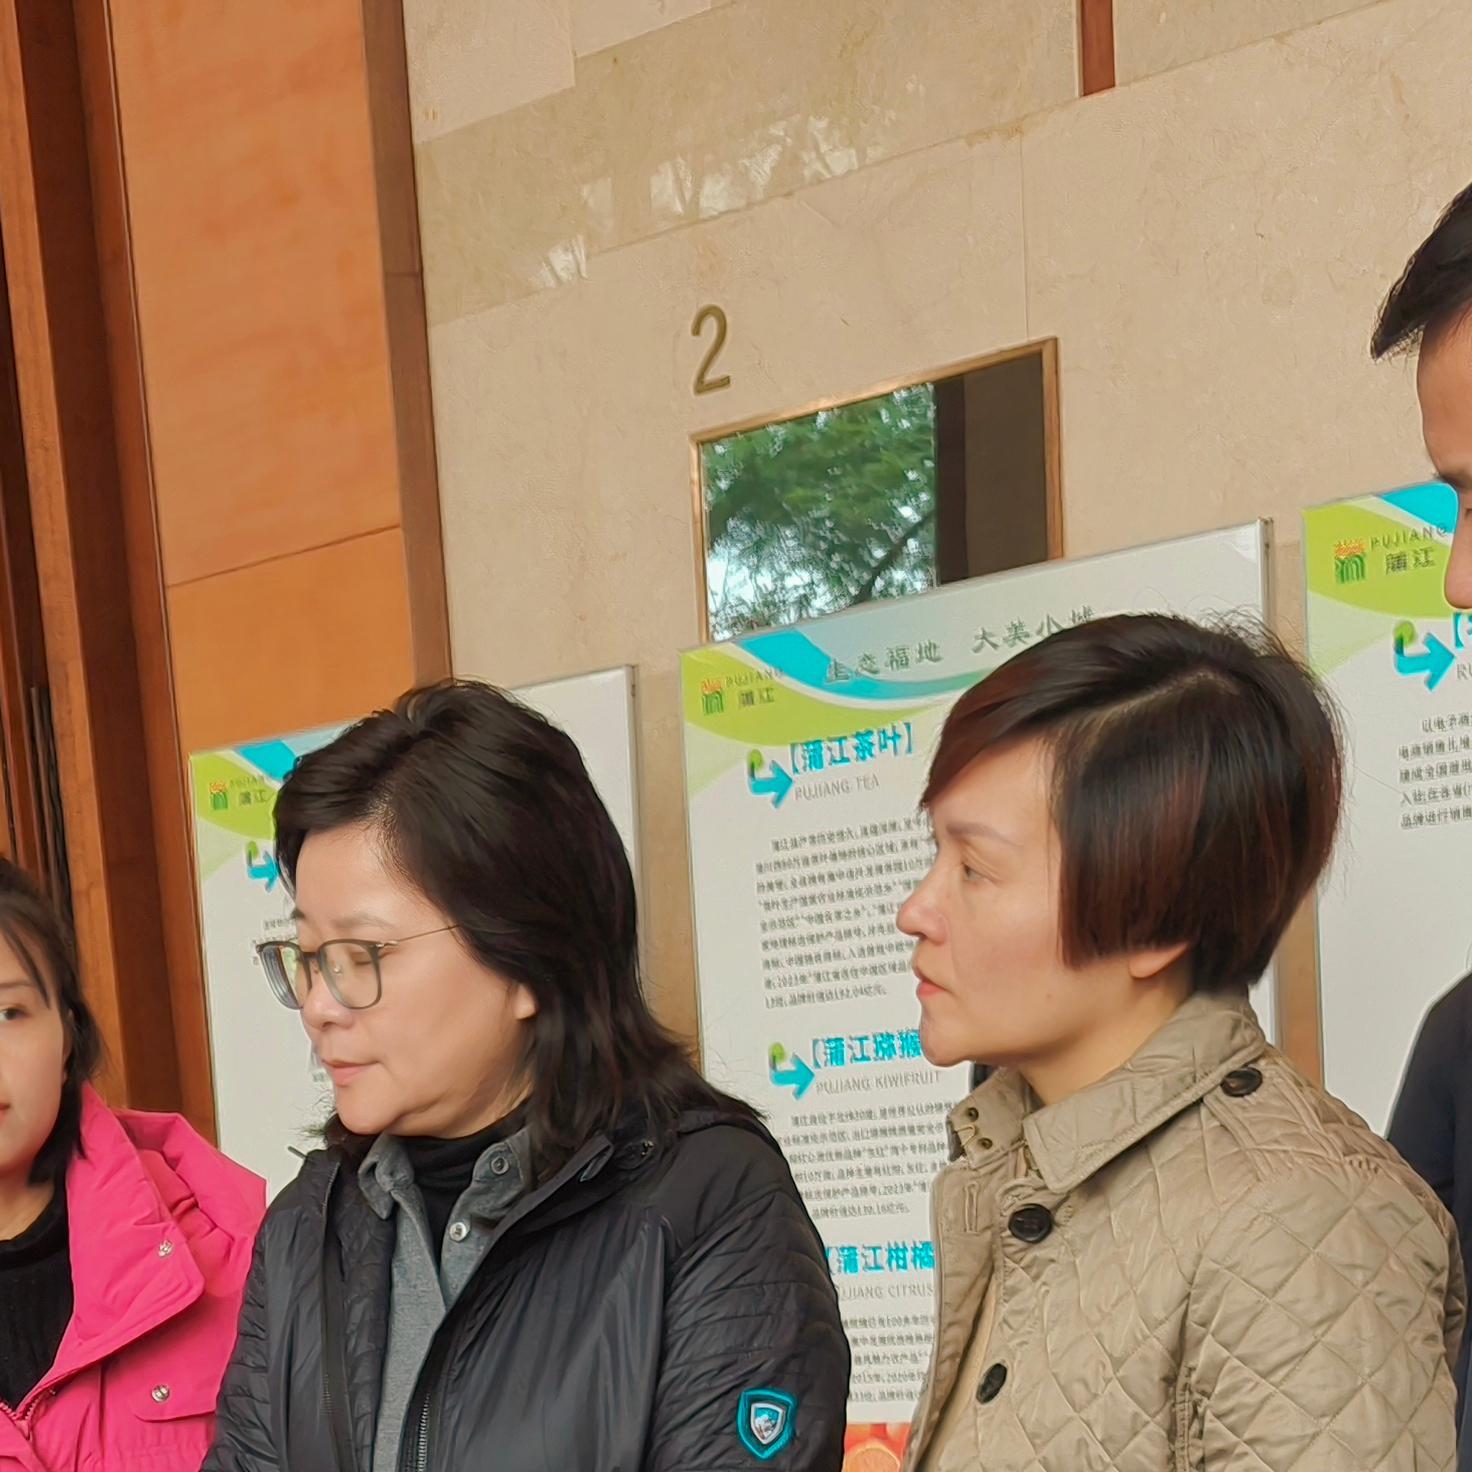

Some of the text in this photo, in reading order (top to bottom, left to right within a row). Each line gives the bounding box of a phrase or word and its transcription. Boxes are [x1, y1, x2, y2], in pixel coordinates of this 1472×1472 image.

[691, 305, 731, 396] 2
[1370, 523, 1449, 553] PUJIANG
[1385, 547, 1436, 577] 蒲江
[826, 639, 944, 684] 生态福地
[738, 688, 775, 708] 蒲江
[790, 721, 916, 776] 【蒲江茶叶】
[794, 774, 880, 802] PUJIANG TEA
[816, 1069, 943, 1095] PUJIANG KIWIFRUIT
[888, 1282, 934, 1300] CITRUS
